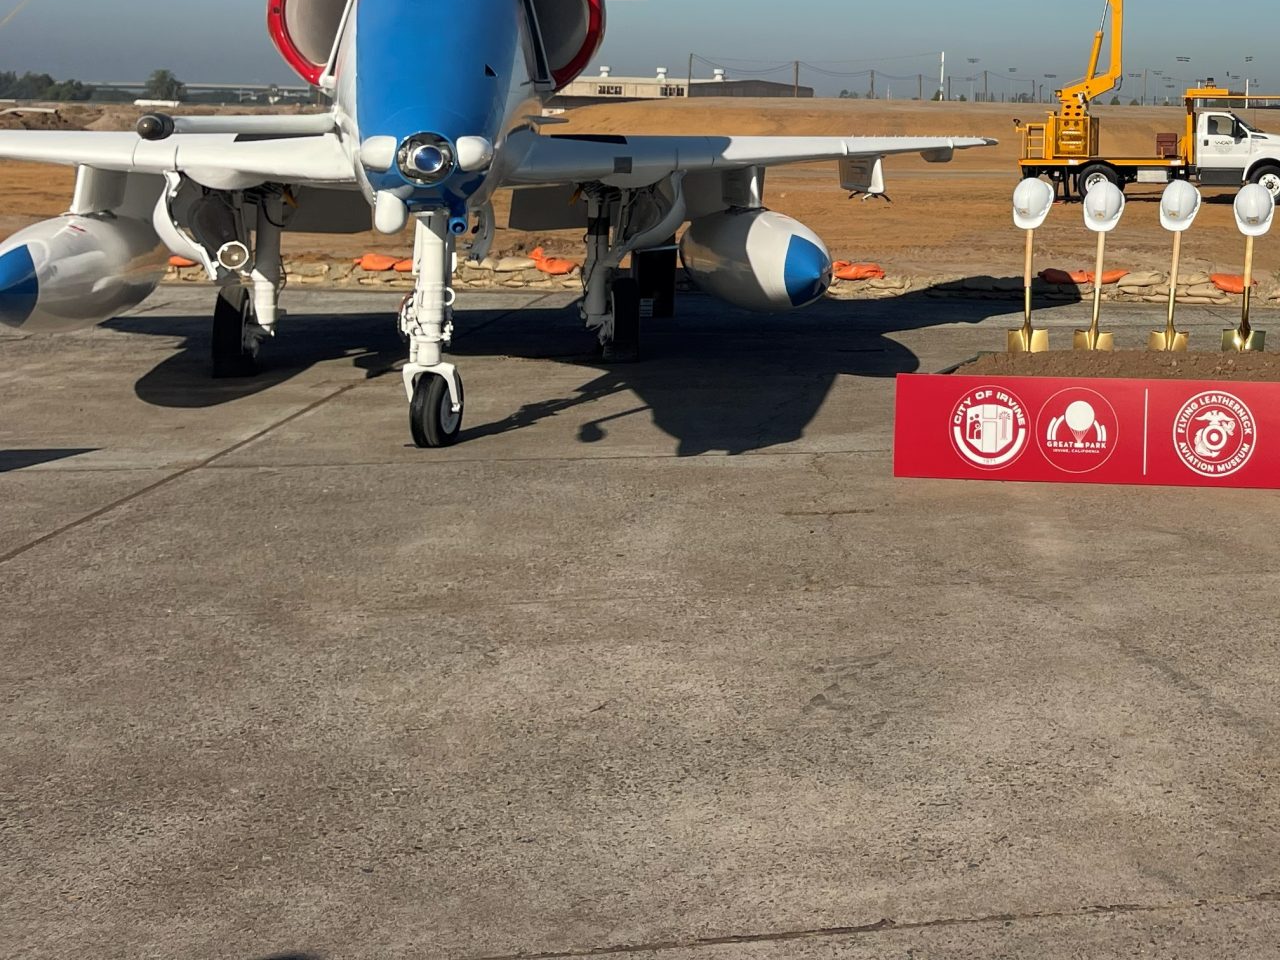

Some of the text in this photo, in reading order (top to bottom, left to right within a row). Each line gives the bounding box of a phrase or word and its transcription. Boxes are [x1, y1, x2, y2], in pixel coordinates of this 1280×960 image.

[954, 390, 1026, 426] CITY OF IRVINE
[1177, 395, 1253, 435] FLYING LEATHERNECK
[1084, 441, 1107, 449] PARK
[1179, 441, 1250, 472] AVIATION MUSEUM
